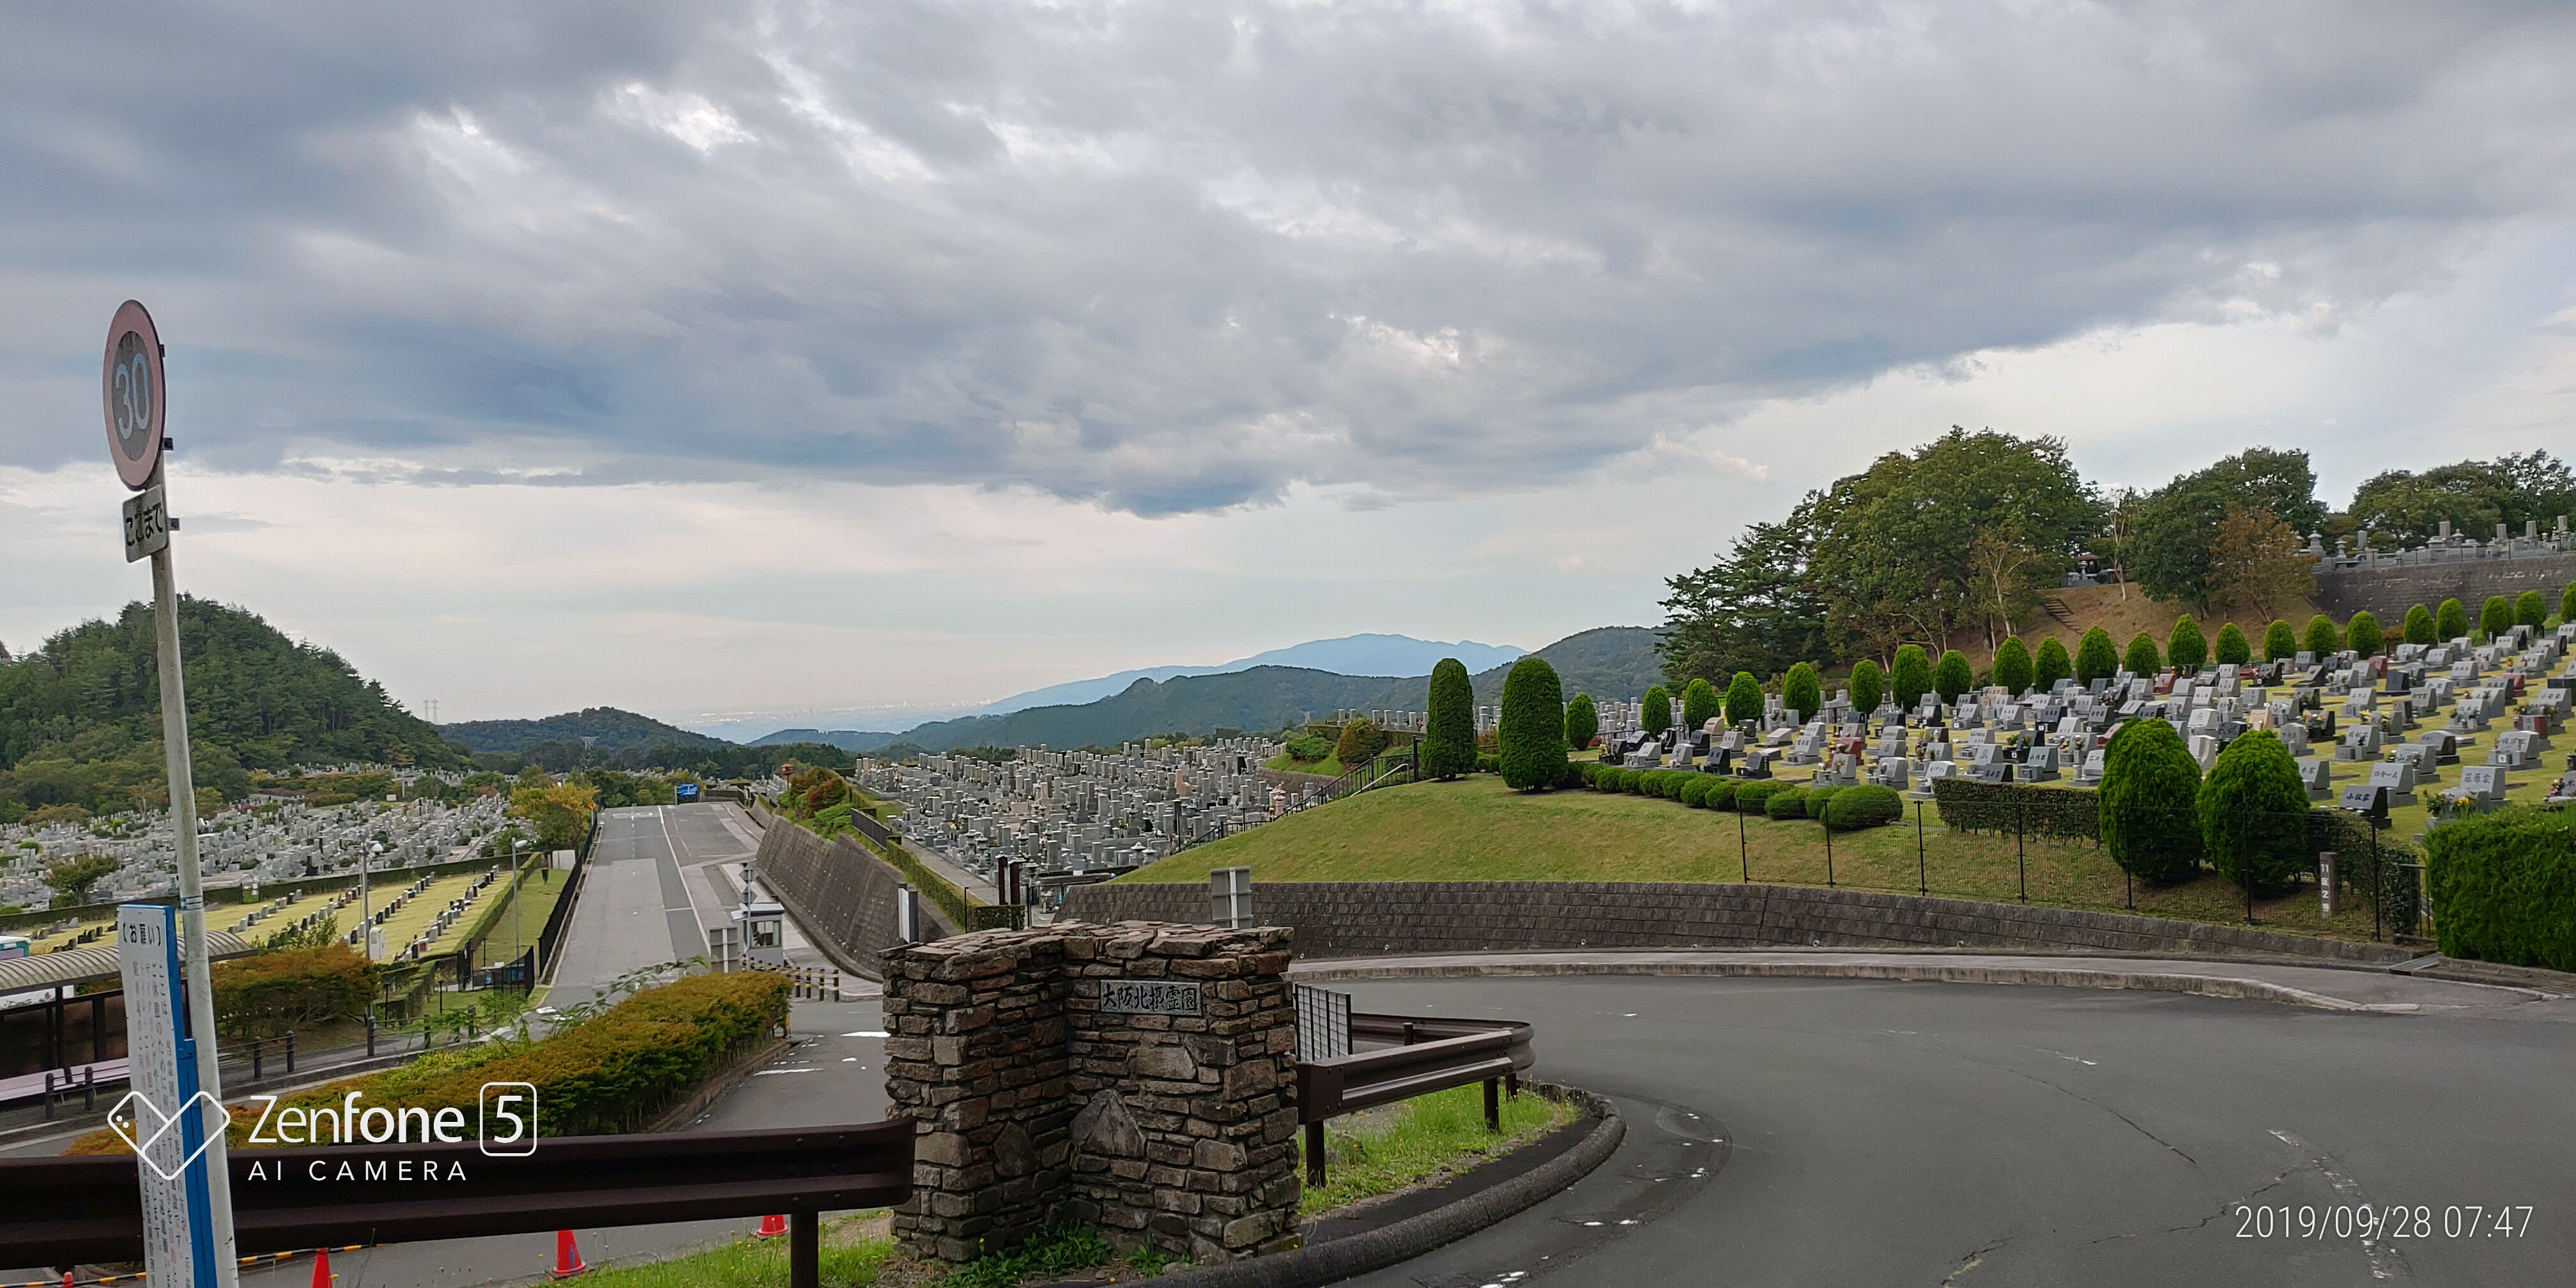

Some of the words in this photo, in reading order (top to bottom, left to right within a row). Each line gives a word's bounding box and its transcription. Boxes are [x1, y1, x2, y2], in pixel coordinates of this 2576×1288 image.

[115, 352, 150, 440] 30
[125, 501, 164, 547] ここまで
[1103, 983, 1197, 1011] 大阪北摂霊園
